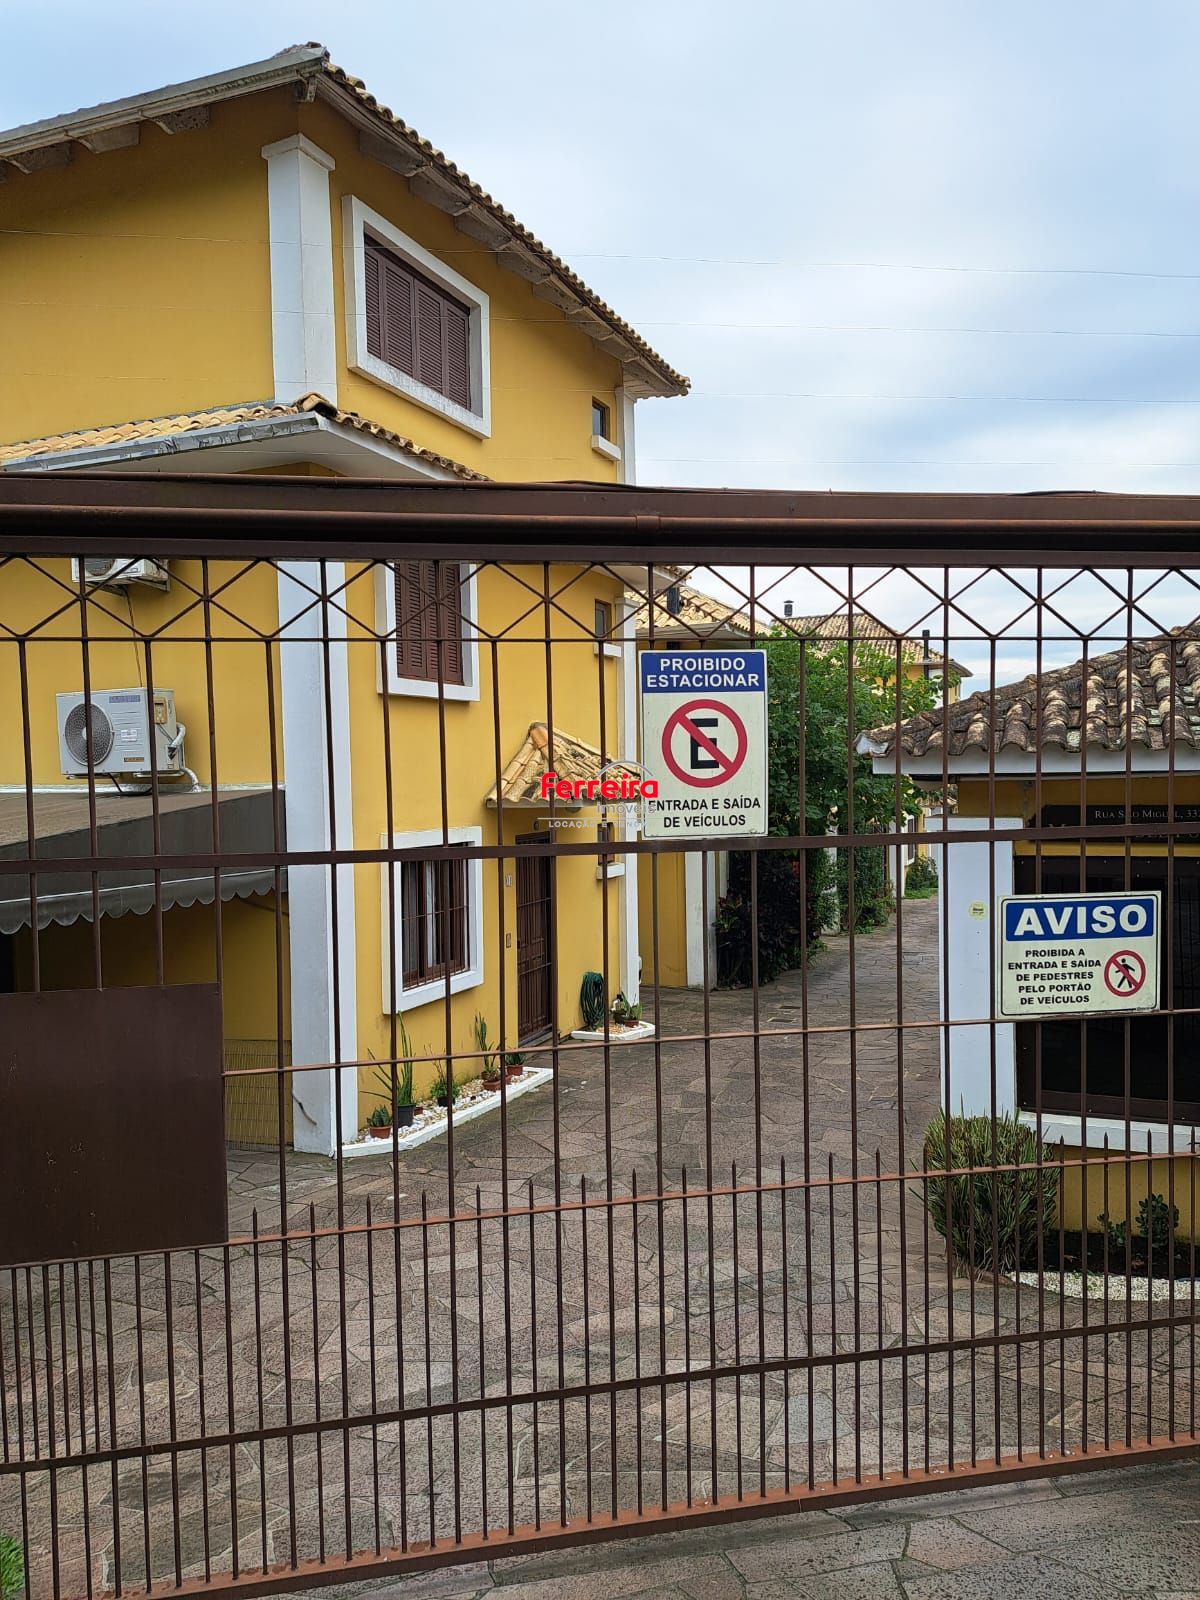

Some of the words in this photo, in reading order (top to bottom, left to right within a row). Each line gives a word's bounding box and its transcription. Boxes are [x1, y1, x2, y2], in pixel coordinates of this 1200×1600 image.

[660, 657, 745, 671] PROIBIDO
[646, 673, 759, 687] ESTACIONAR
[689, 718, 719, 769] E
[648, 799, 708, 811] ENTRADA
[711, 798, 719, 810] E
[723, 795, 761, 809] SAÍDA
[663, 816, 680, 828] DE
[684, 813, 746, 827] VEÍCULOS
[1118, 809, 1139, 818] SO
[1142, 809, 1184, 819] MIGUL,
[1013, 904, 1147, 936] AVISO
[1025, 949, 1075, 958] PROIBIDA
[1078, 948, 1085, 956] A
[1008, 961, 1058, 970] ENTRADA
[1061, 960, 1068, 968] E
[1070, 958, 1102, 968] SAÍDA
[1016, 973, 1030, 982] DE
[1033, 971, 1094, 981] PEDESTRES
[1018, 985, 1046, 993] PELO
[1049, 982, 1092, 993] PORTÃO
[1020, 997, 1035, 1005] DE
[1037, 995, 1090, 1005] VEÍCULOS
